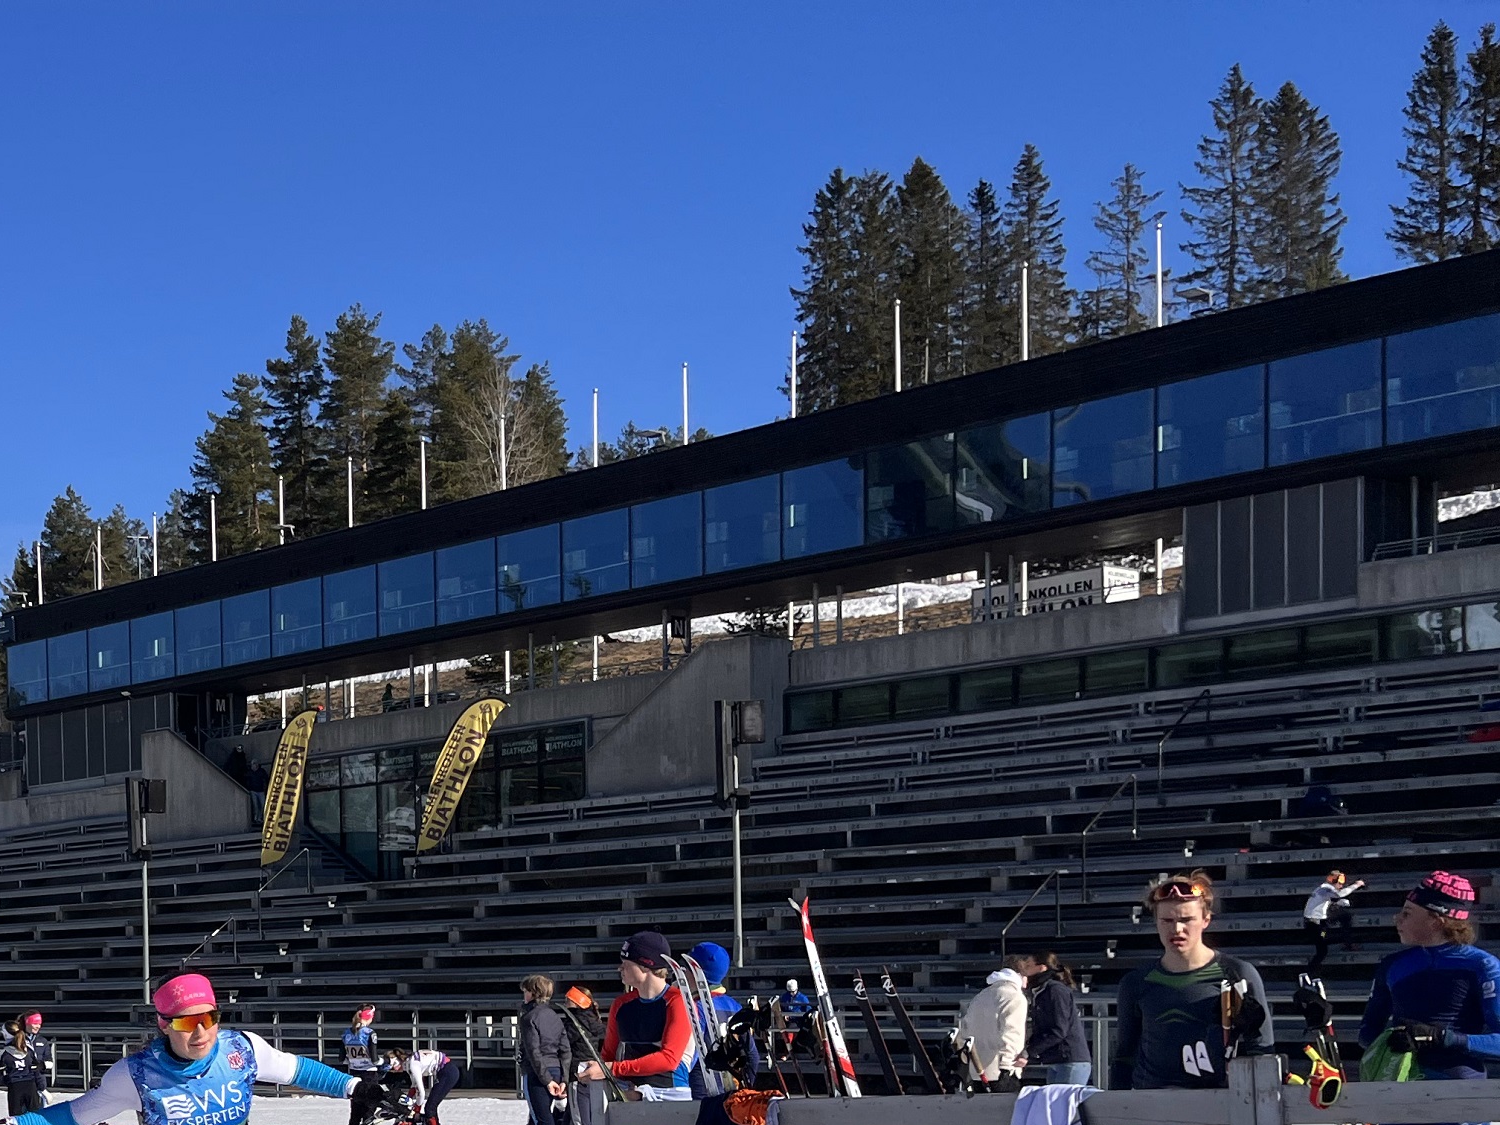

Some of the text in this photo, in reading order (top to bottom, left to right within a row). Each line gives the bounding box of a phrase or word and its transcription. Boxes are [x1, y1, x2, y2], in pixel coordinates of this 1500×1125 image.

[982, 580, 1093, 607] OLNKOLLEN
[501, 744, 538, 756] BIATHLON
[546, 739, 583, 752] IATHLON
[261, 743, 289, 850] HOLMENKOLLEN
[273, 744, 306, 852] BIATHLON
[425, 728, 486, 841] BIATHLON
[192, 1080, 243, 1113] VVS
